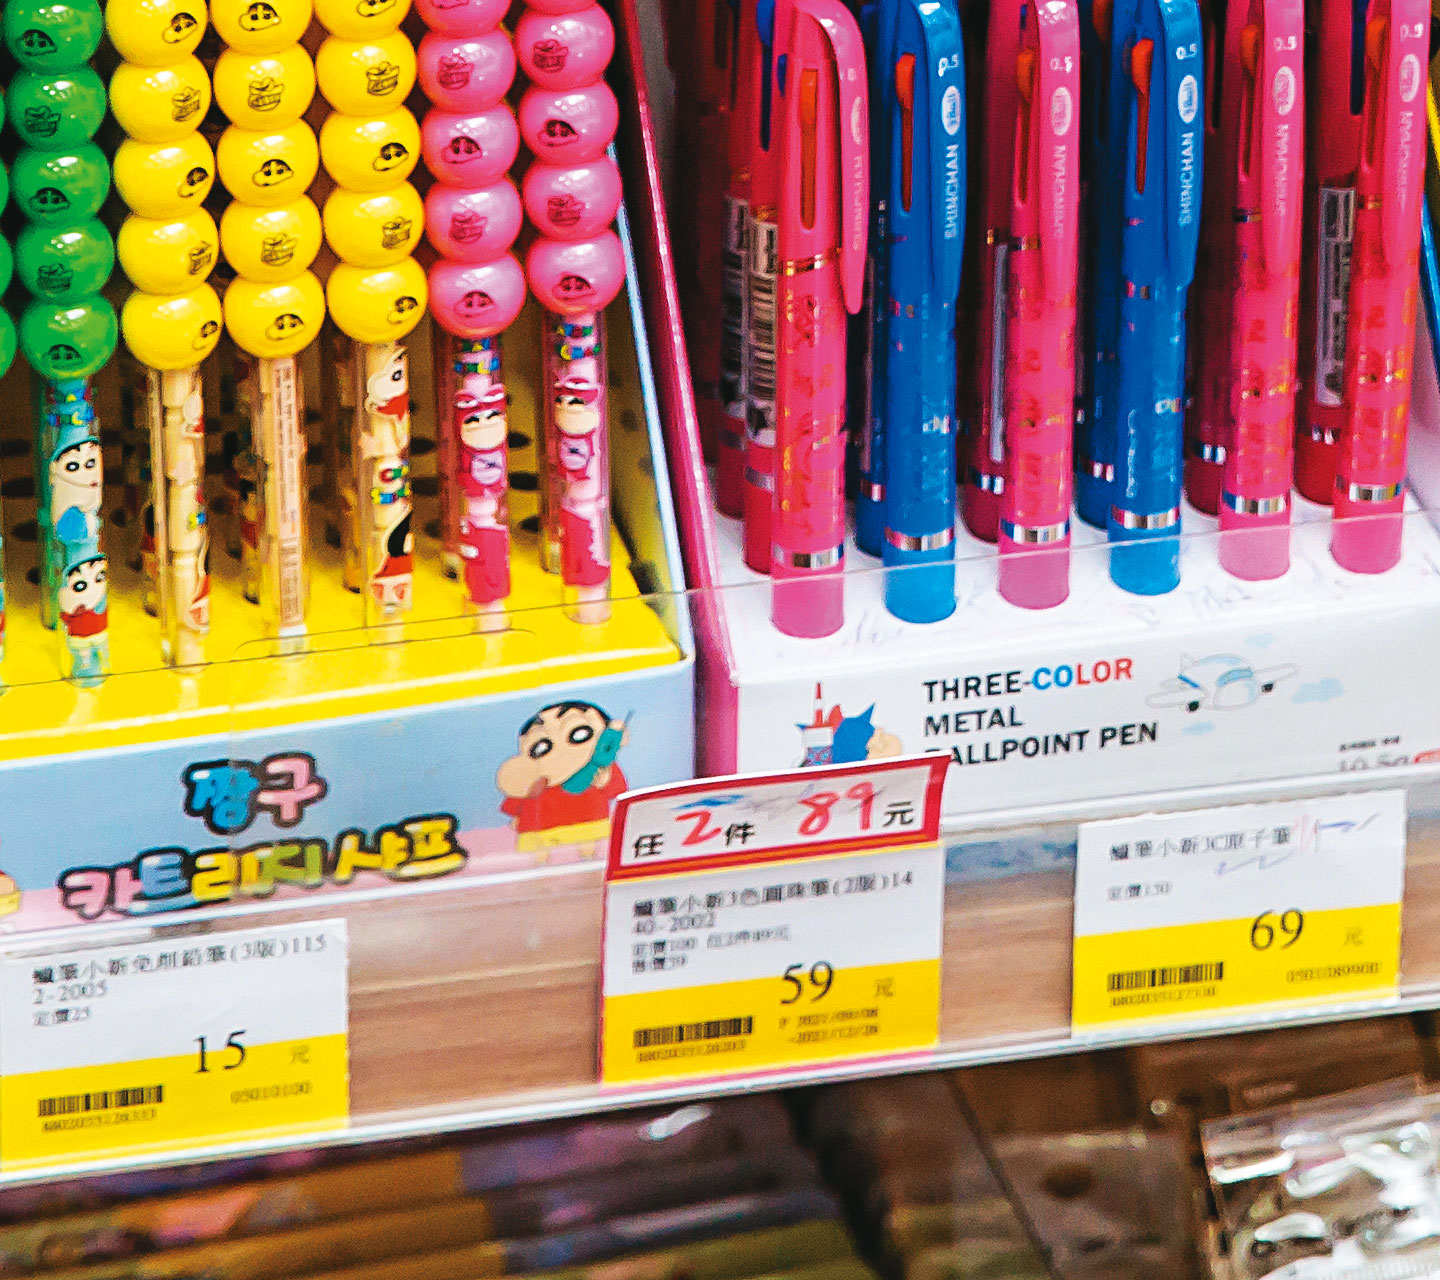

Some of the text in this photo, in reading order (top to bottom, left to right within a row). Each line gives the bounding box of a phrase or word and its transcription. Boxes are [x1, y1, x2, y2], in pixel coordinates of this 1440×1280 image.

[923, 657, 1133, 704] THREE-COLOR
[923, 706, 1025, 738] METAL
[1099, 721, 1159, 749] PEN
[183, 752, 327, 834] 짱구
[675, 782, 914, 851] 2 件 89 元
[1248, 908, 1305, 951] 69
[779, 961, 834, 1005] 59
[191, 1029, 247, 1075] 15
